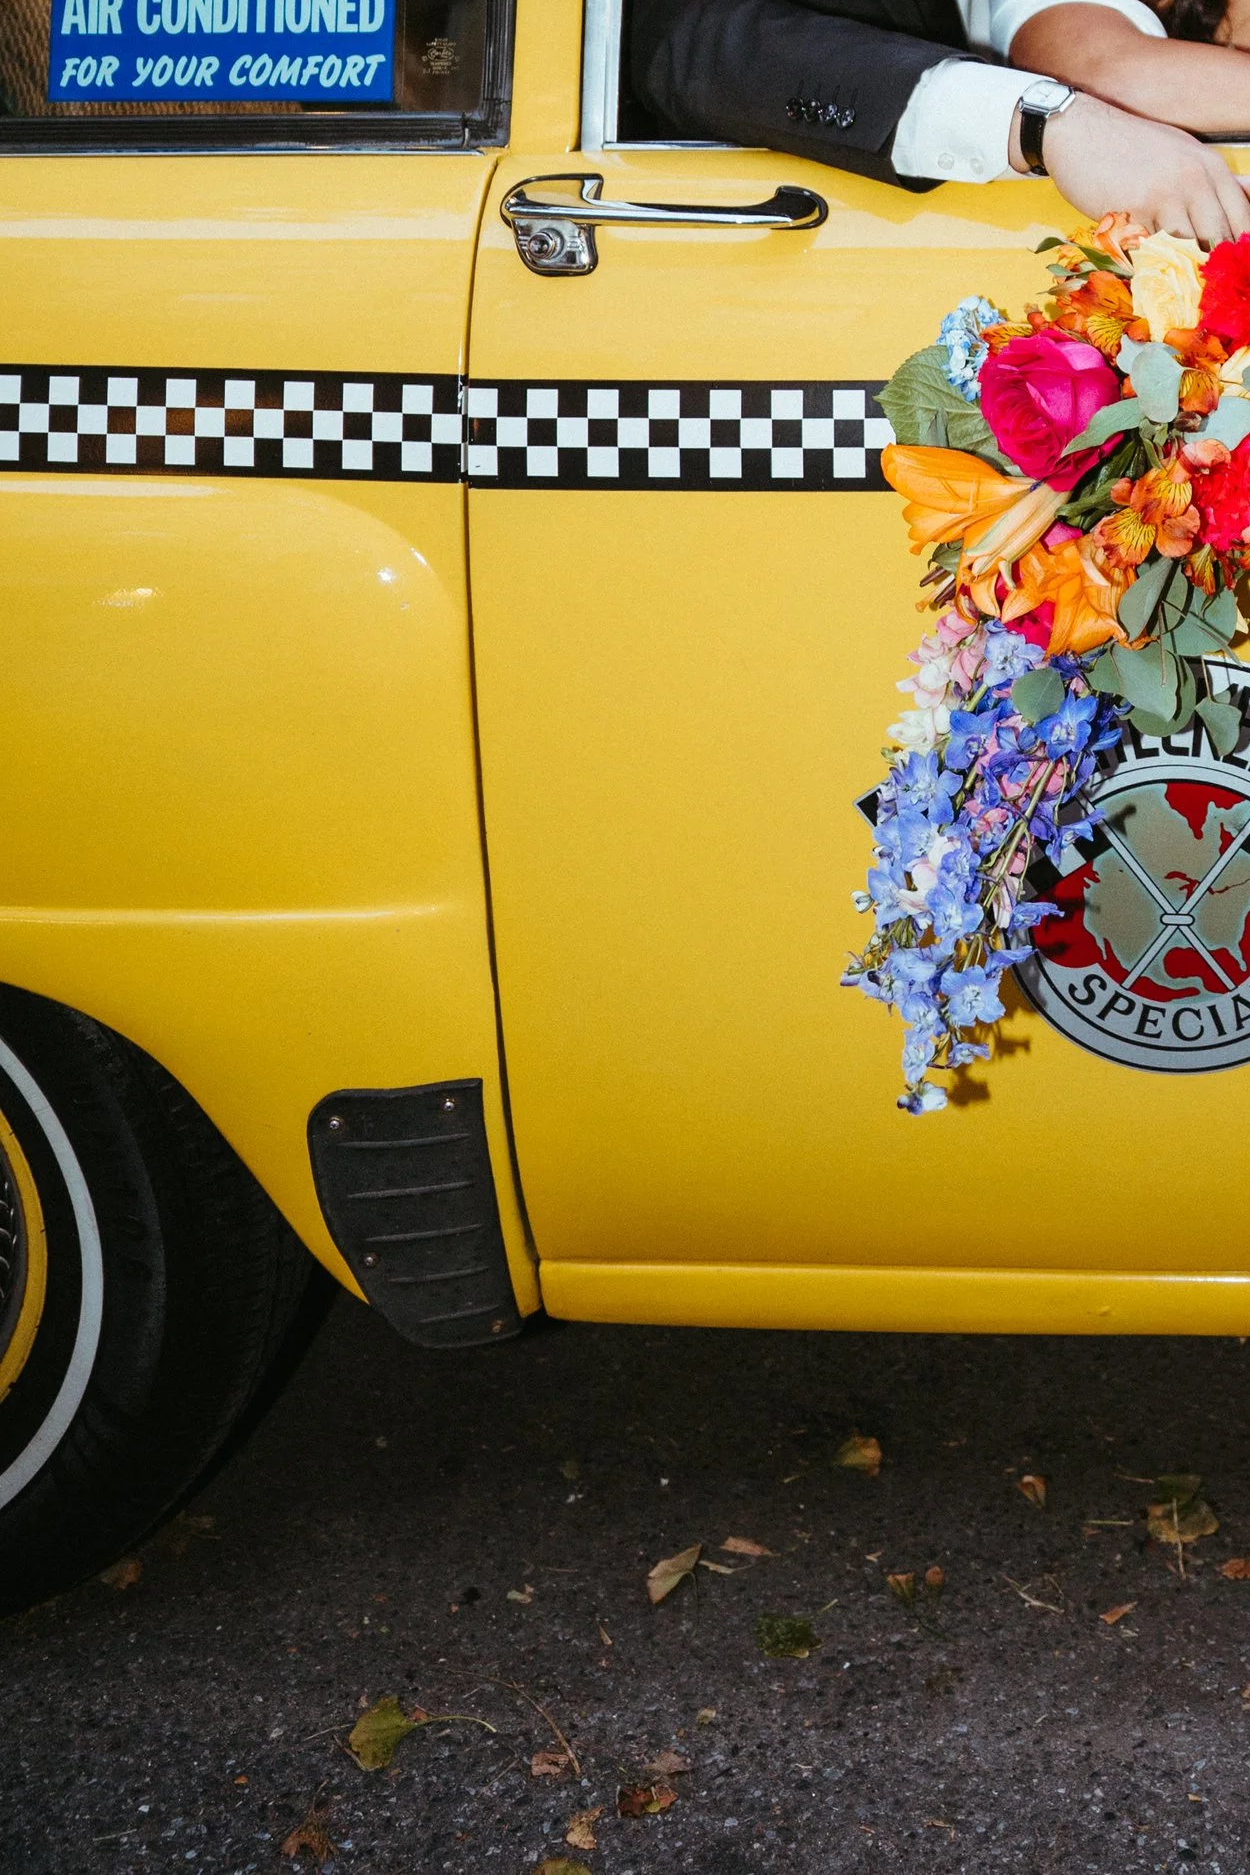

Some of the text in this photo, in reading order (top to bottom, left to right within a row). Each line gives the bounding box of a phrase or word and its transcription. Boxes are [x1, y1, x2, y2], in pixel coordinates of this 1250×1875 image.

[59, 55, 120, 88] FOR
[131, 54, 220, 88] YOUR
[228, 53, 386, 88] COMFORT
